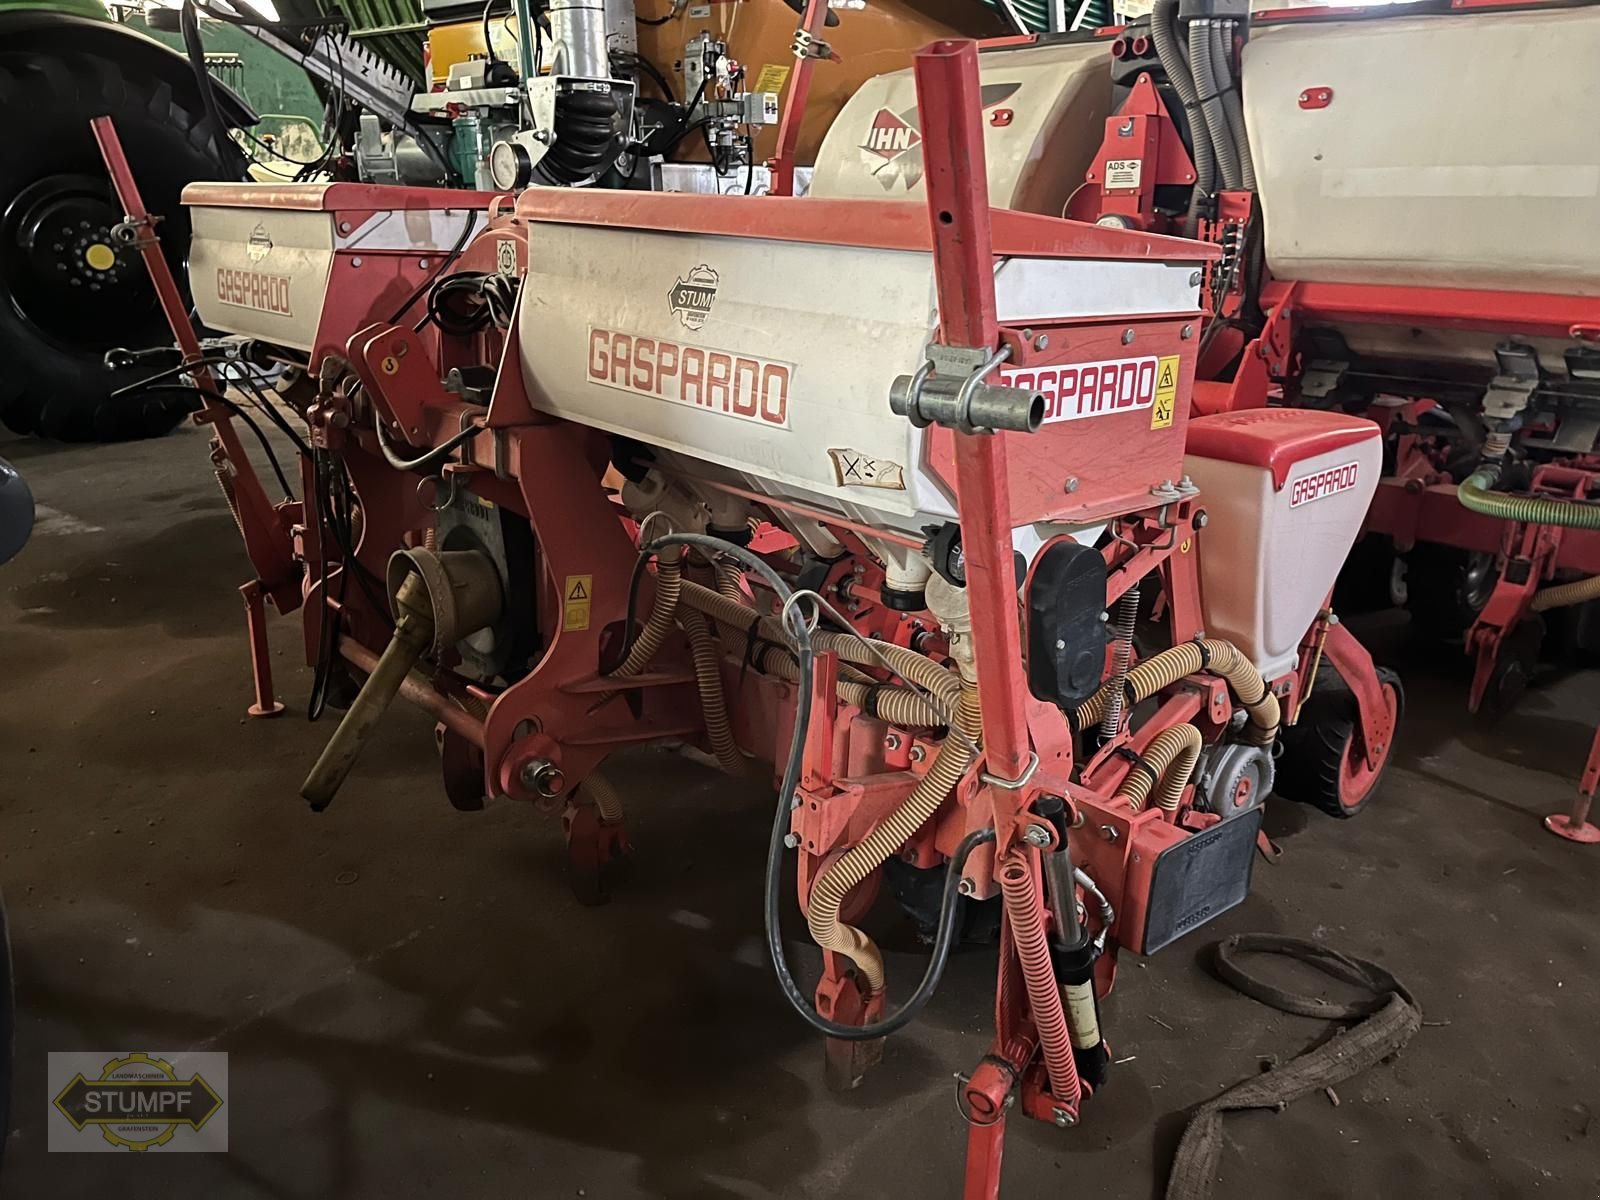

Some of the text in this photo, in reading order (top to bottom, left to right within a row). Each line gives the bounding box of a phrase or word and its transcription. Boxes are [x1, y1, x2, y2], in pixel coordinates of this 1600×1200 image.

[1108, 162, 1126, 170] ADS
[217, 268, 289, 313] GASPARDO
[589, 328, 789, 425] GASPARDO
[1001, 360, 1156, 418] SPARDO
[1291, 464, 1358, 506] GASPARDO
